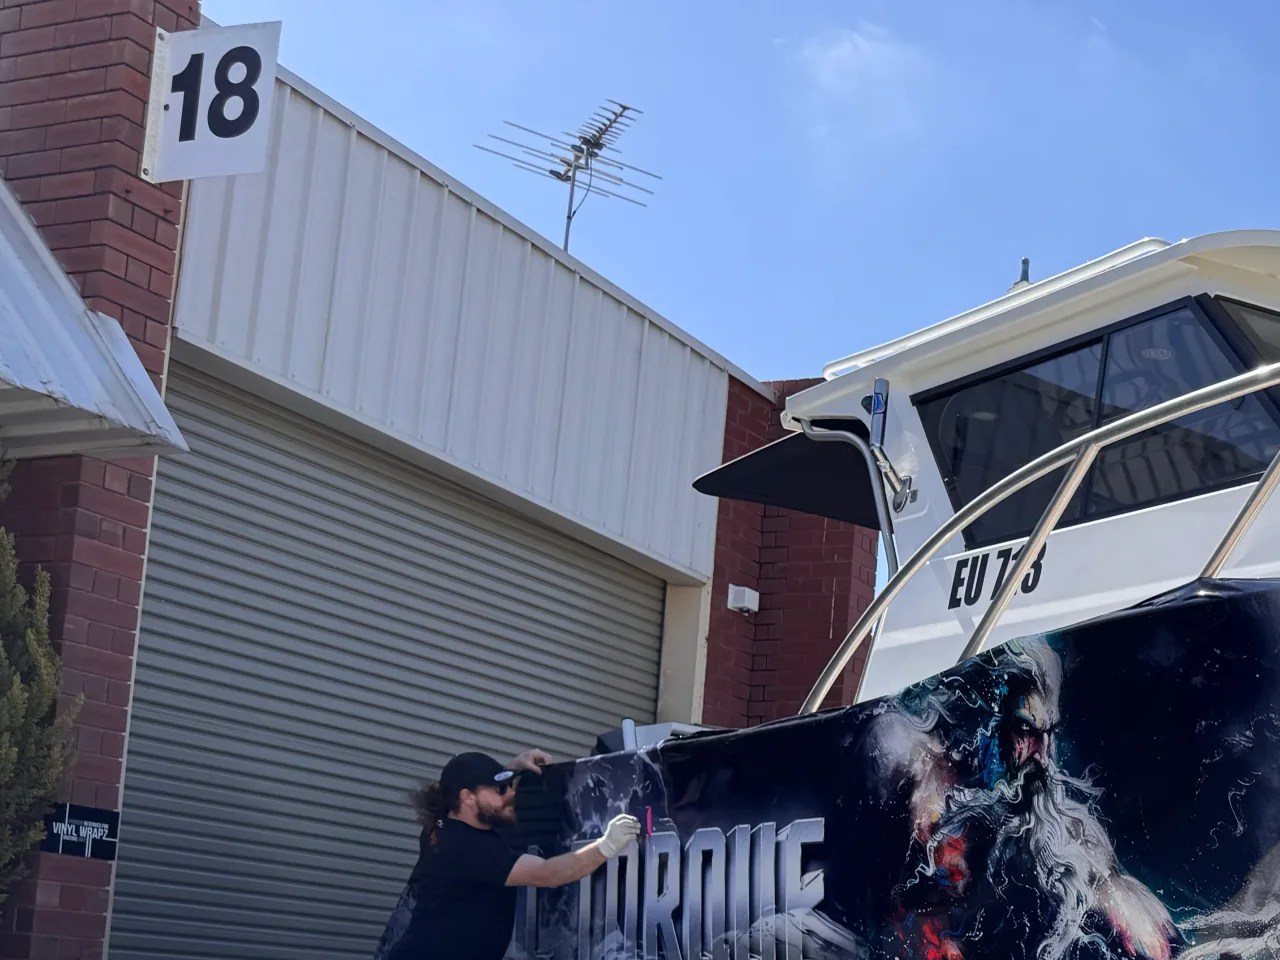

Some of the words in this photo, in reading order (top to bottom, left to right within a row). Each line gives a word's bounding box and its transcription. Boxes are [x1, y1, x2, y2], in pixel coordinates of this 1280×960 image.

[171, 45, 262, 142] 18
[947, 552, 990, 610] EU
[989, 541, 1047, 602] 73
[52, 821, 78, 836] VINYL
[79, 825, 109, 840] WRAPZ
